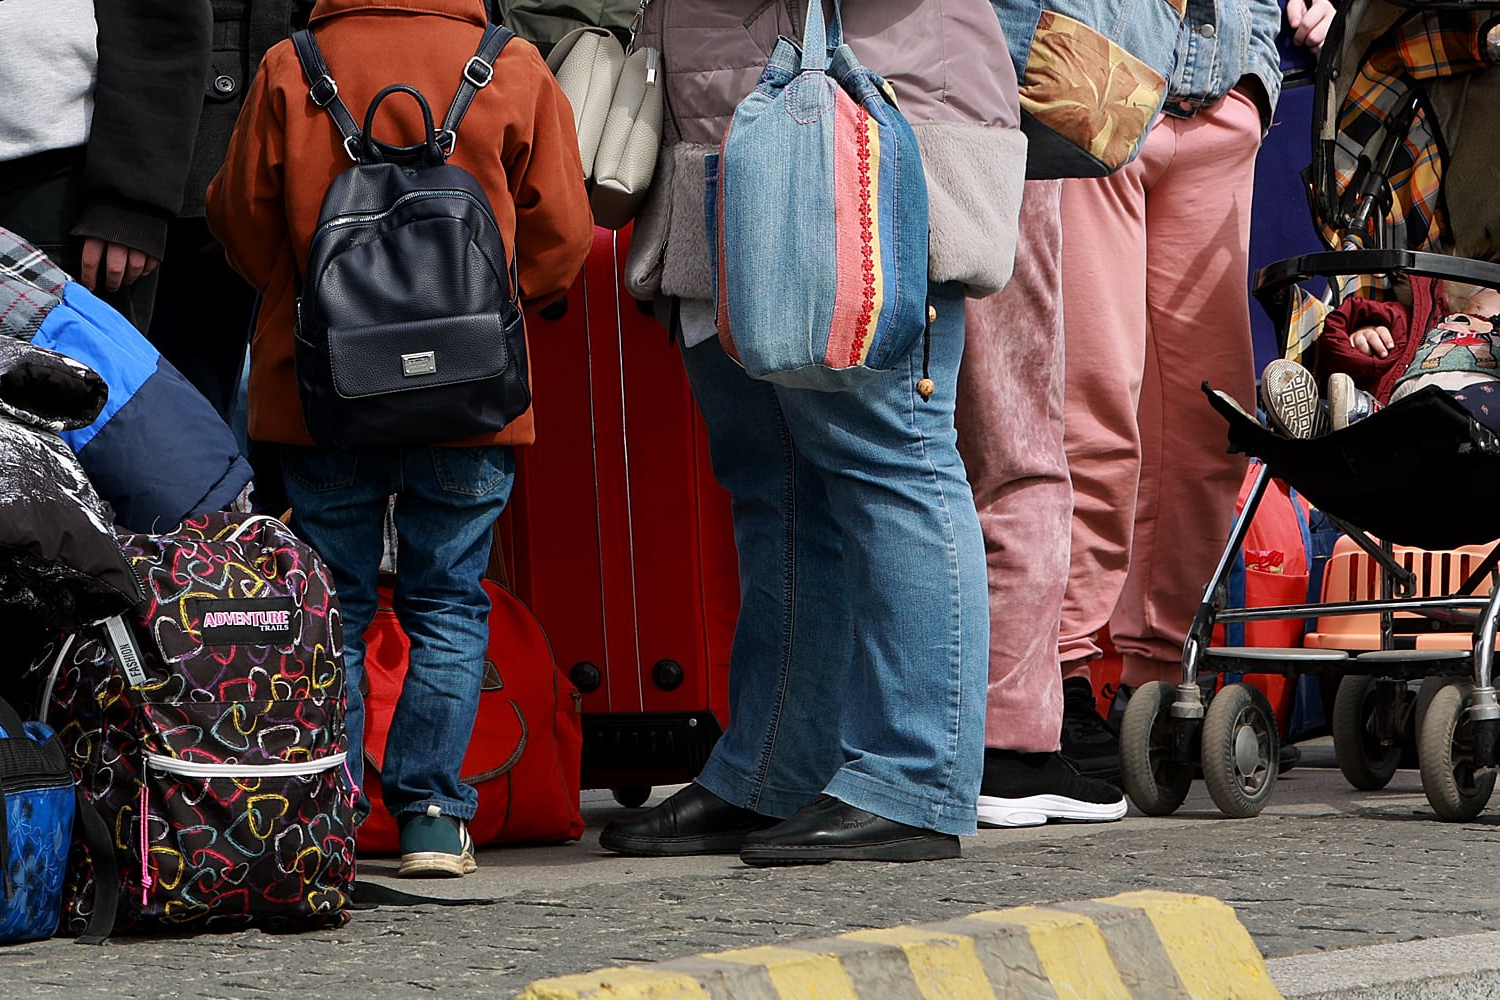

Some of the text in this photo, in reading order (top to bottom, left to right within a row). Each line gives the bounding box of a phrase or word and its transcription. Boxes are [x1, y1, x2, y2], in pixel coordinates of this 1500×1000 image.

[204, 610, 290, 628] ADVENTURE
[260, 624, 289, 632] TRAILS
[119, 643, 142, 677] FASHION
